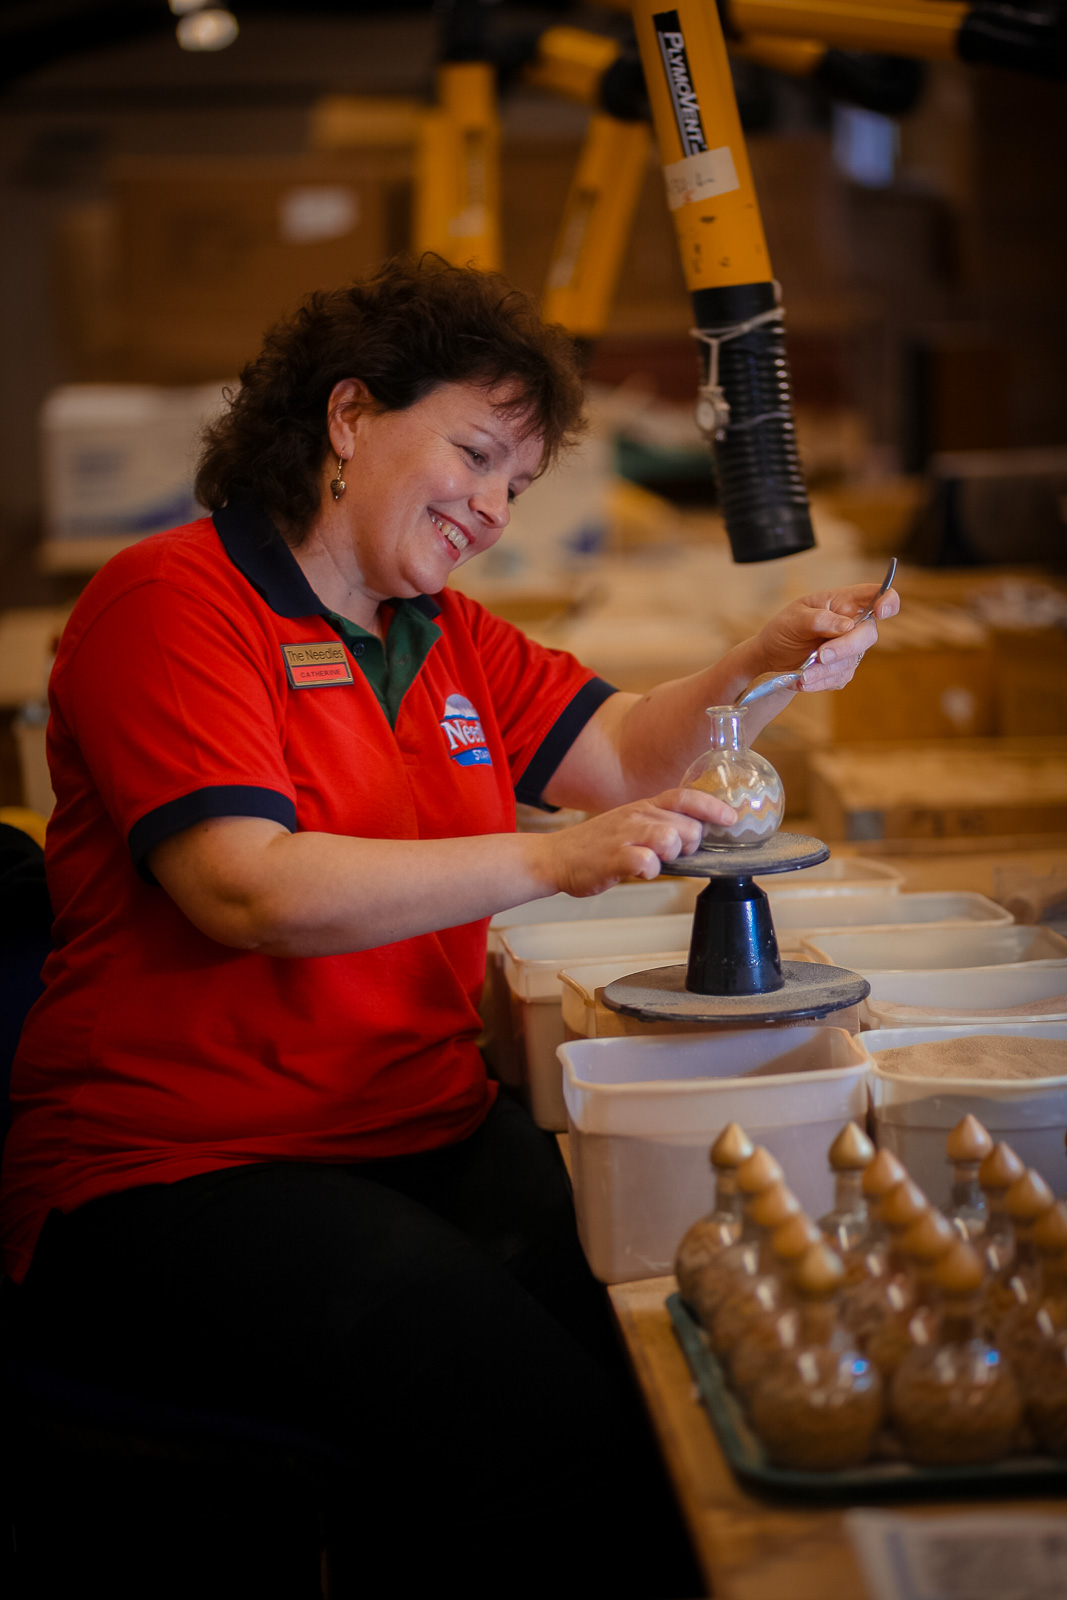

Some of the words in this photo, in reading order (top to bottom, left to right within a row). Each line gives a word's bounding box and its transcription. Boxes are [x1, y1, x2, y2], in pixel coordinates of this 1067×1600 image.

[286, 650, 305, 662] The
[305, 647, 344, 660] Needles
[300, 668, 341, 678] CATHERINE
